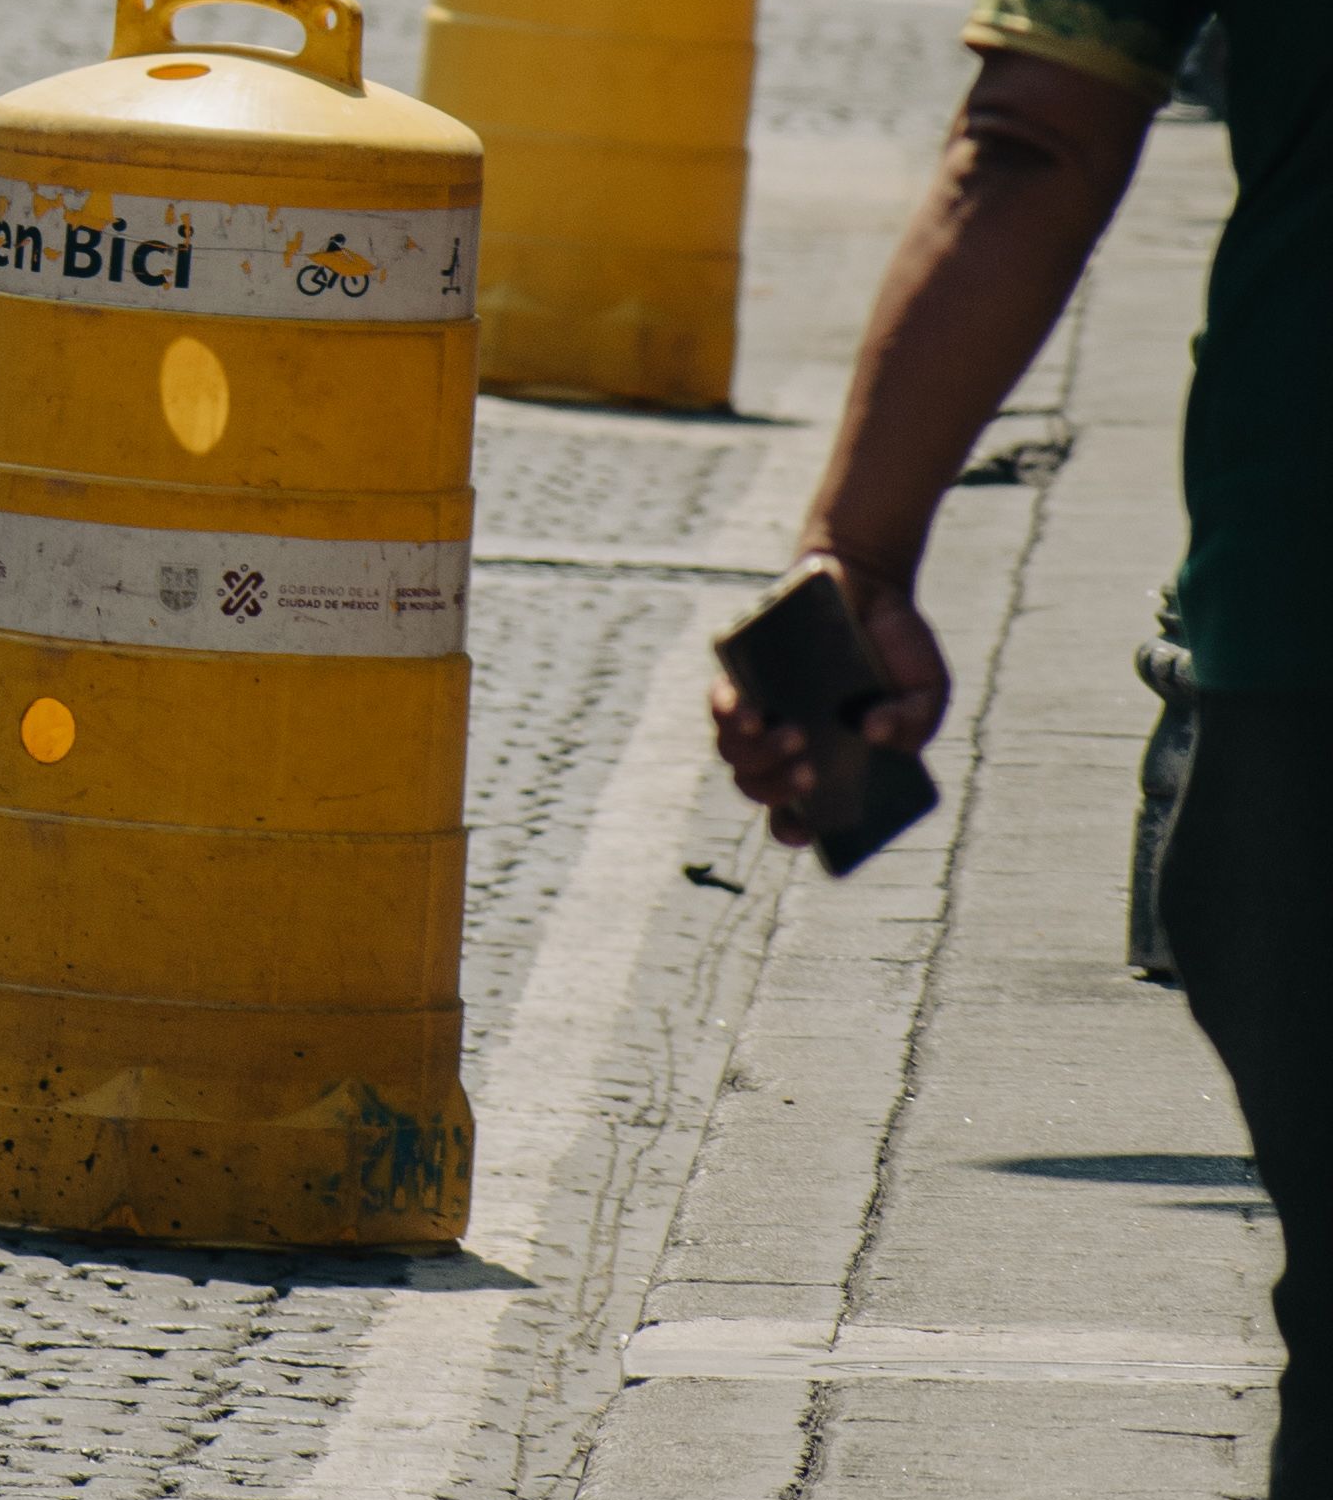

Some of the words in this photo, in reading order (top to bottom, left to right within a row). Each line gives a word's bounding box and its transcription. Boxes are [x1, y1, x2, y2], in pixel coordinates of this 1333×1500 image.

[63, 217, 194, 289] Bici
[279, 584, 344, 597] GOBIERNO
[348, 587, 363, 597] DE
[366, 588, 380, 598] LA
[277, 597, 322, 609] CIUDAD
[324, 599, 339, 609] DE
[342, 598, 380, 611] MÉXICO
